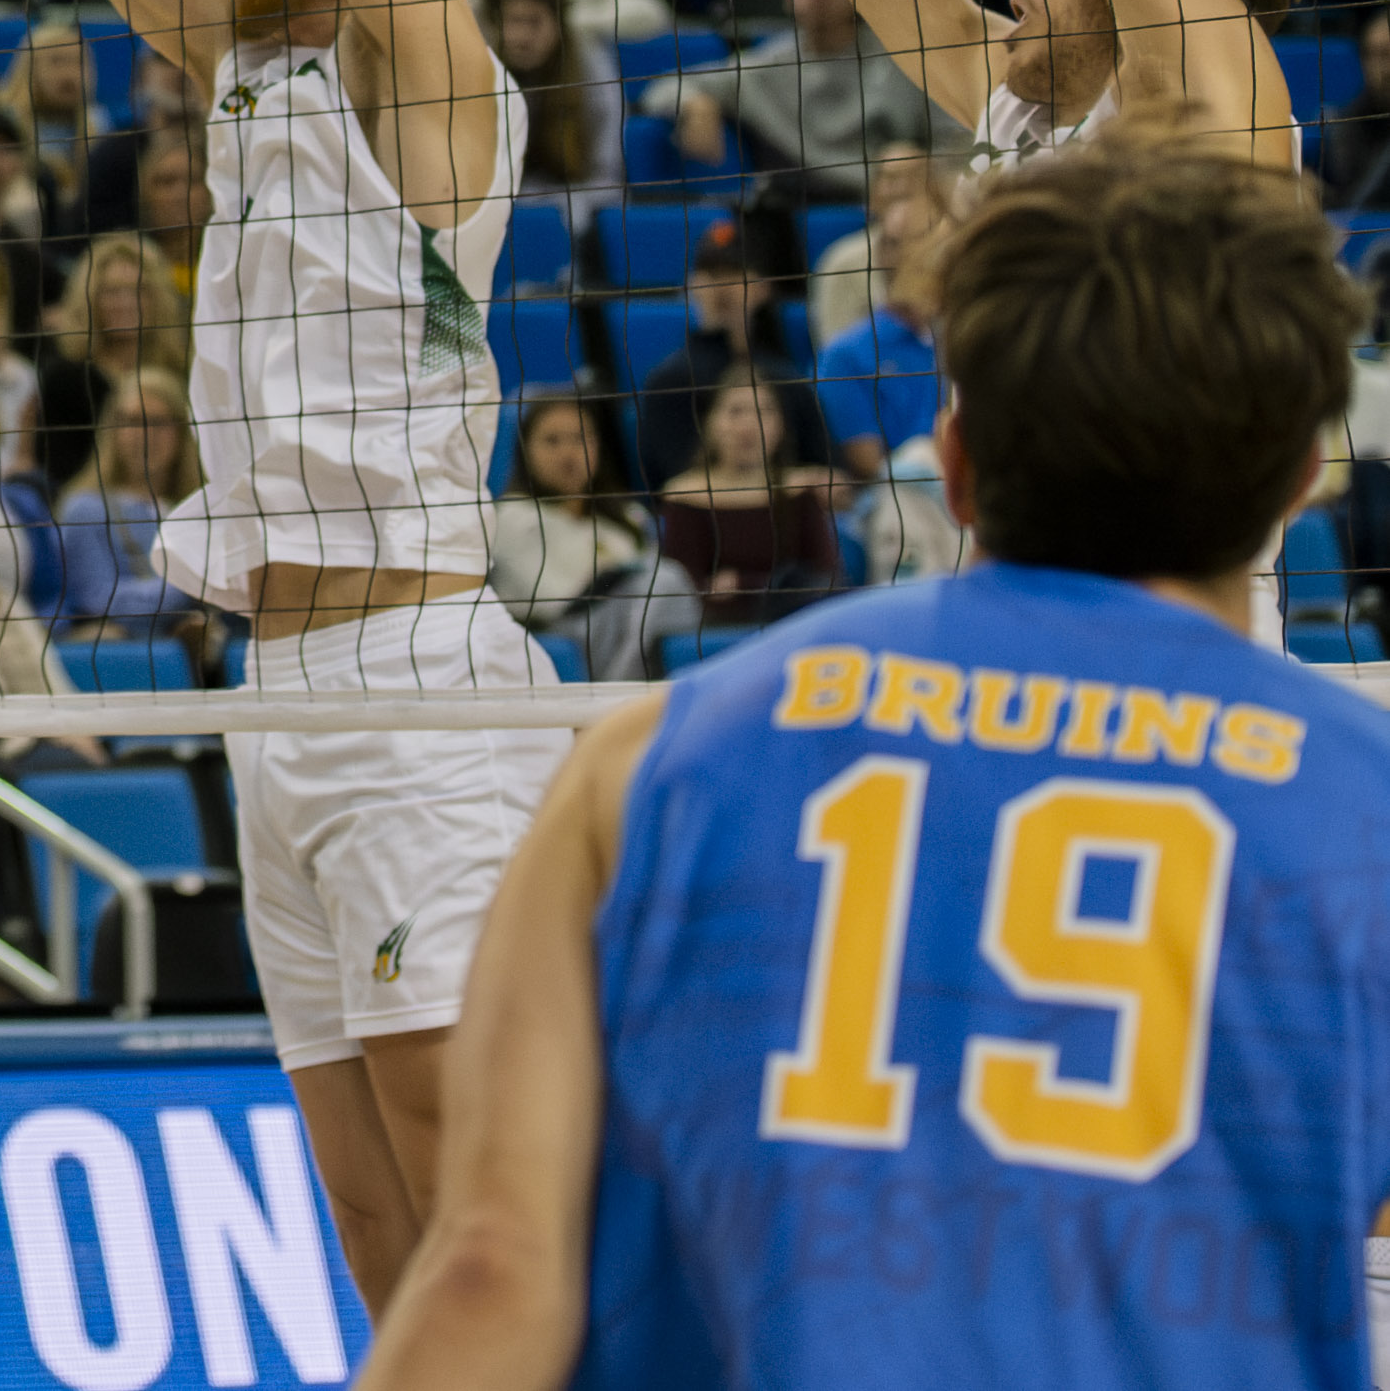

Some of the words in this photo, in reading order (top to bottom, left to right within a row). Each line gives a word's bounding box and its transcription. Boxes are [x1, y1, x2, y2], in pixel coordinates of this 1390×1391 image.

[773, 644, 1306, 784] BRUINS
[759, 754, 1237, 1184] 19
[0, 1105, 348, 1391] ON
